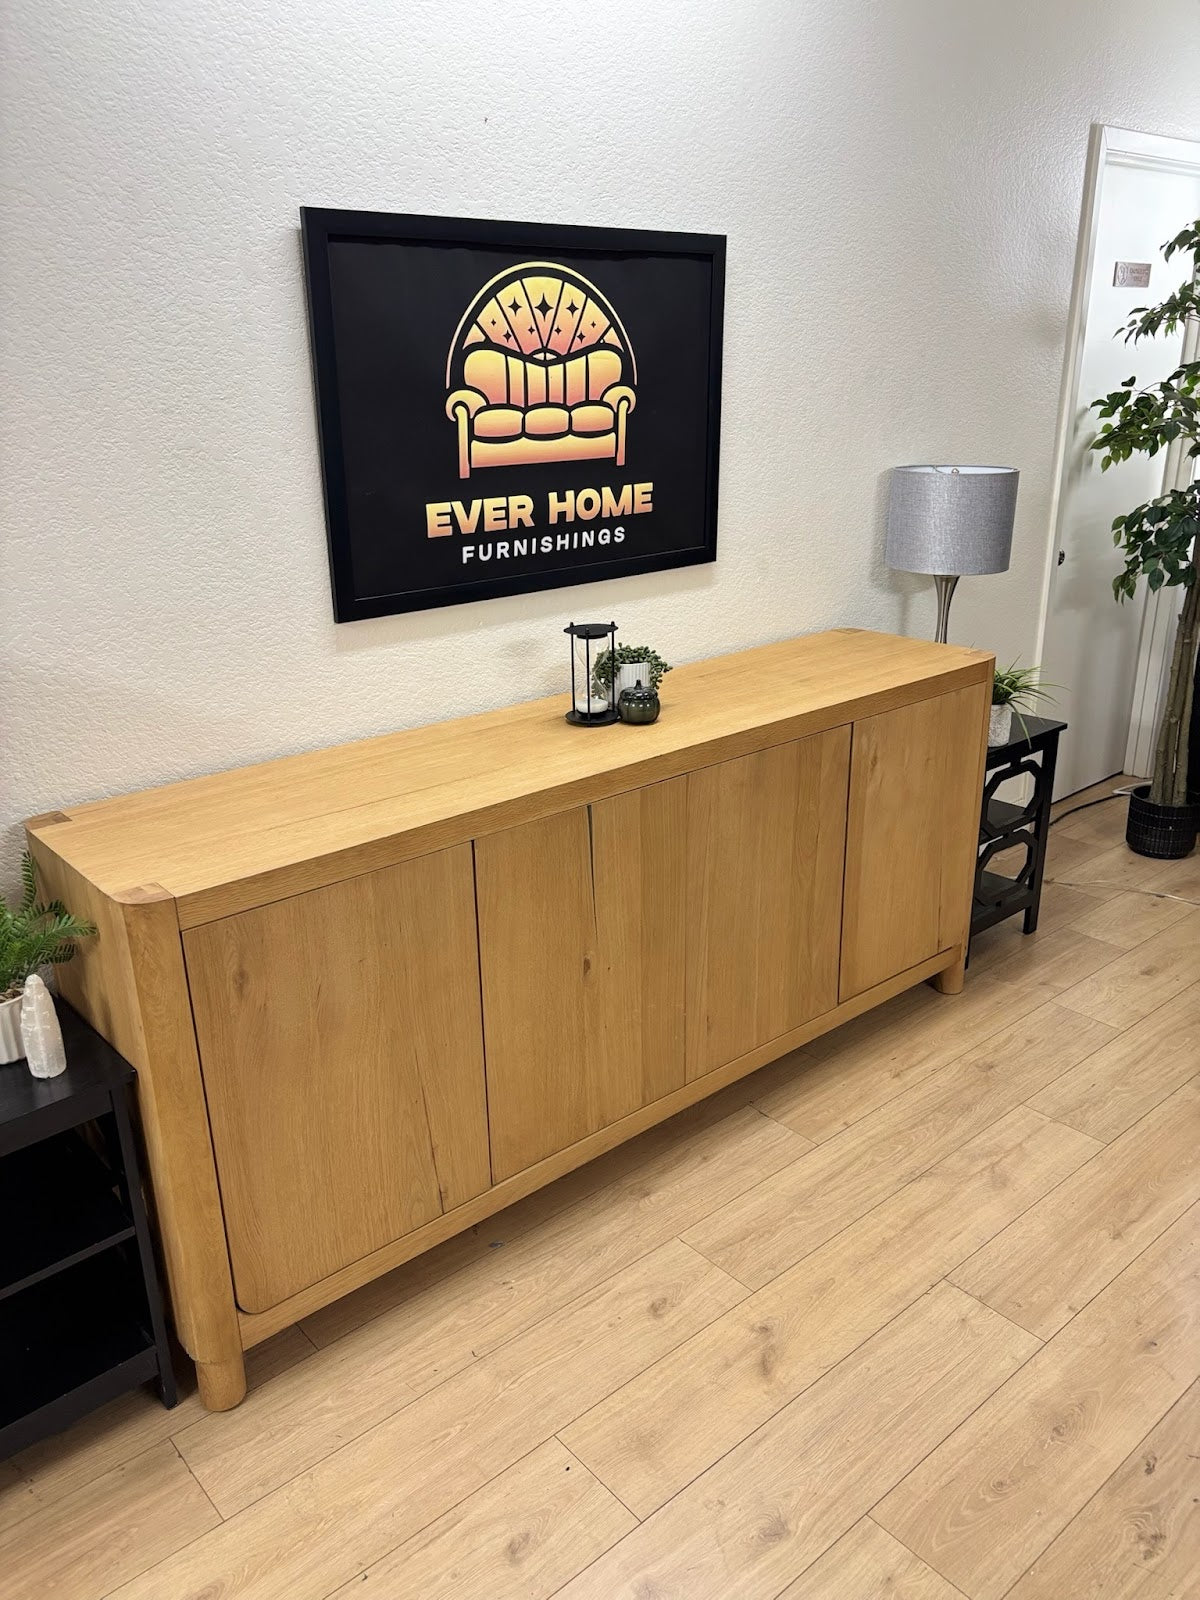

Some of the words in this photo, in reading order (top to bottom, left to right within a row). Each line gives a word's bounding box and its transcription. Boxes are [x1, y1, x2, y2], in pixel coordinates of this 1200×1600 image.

[425, 494, 535, 539] EVER
[548, 482, 654, 525] HOME
[461, 526, 626, 564] FURNISHINGS
